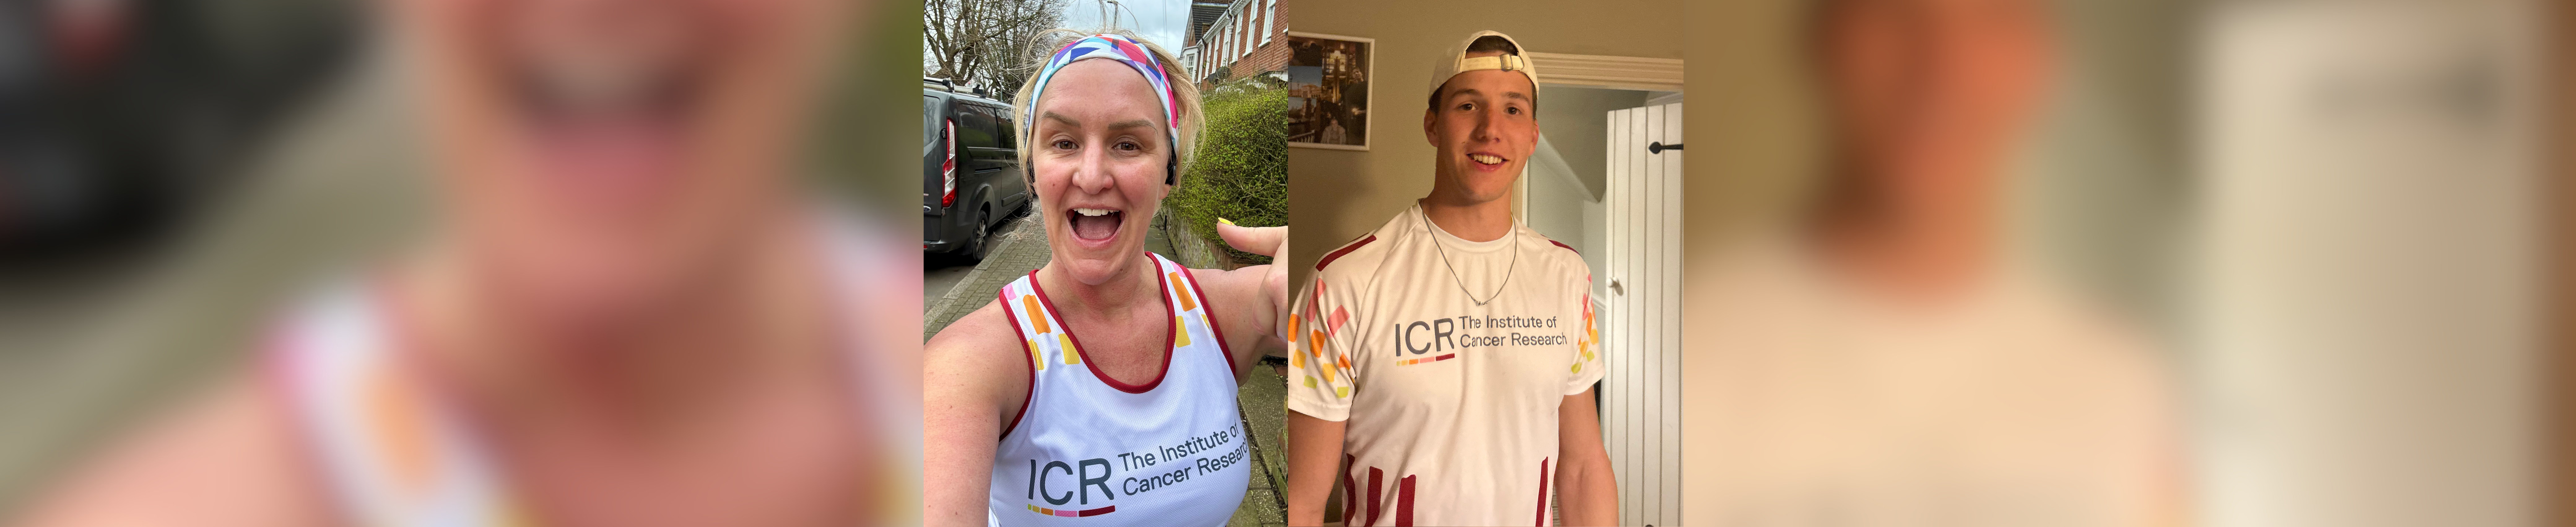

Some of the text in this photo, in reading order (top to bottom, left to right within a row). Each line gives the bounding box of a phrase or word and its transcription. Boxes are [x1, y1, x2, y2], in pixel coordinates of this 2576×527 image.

[1395, 317, 1455, 357] ICR
[1458, 315, 1557, 330] The Institute of
[1460, 332, 1567, 348] Cancer Research
[1118, 419, 1239, 472] The Institute of
[1123, 435, 1248, 496] Cancer Research
[1028, 458, 1114, 505] ICR
